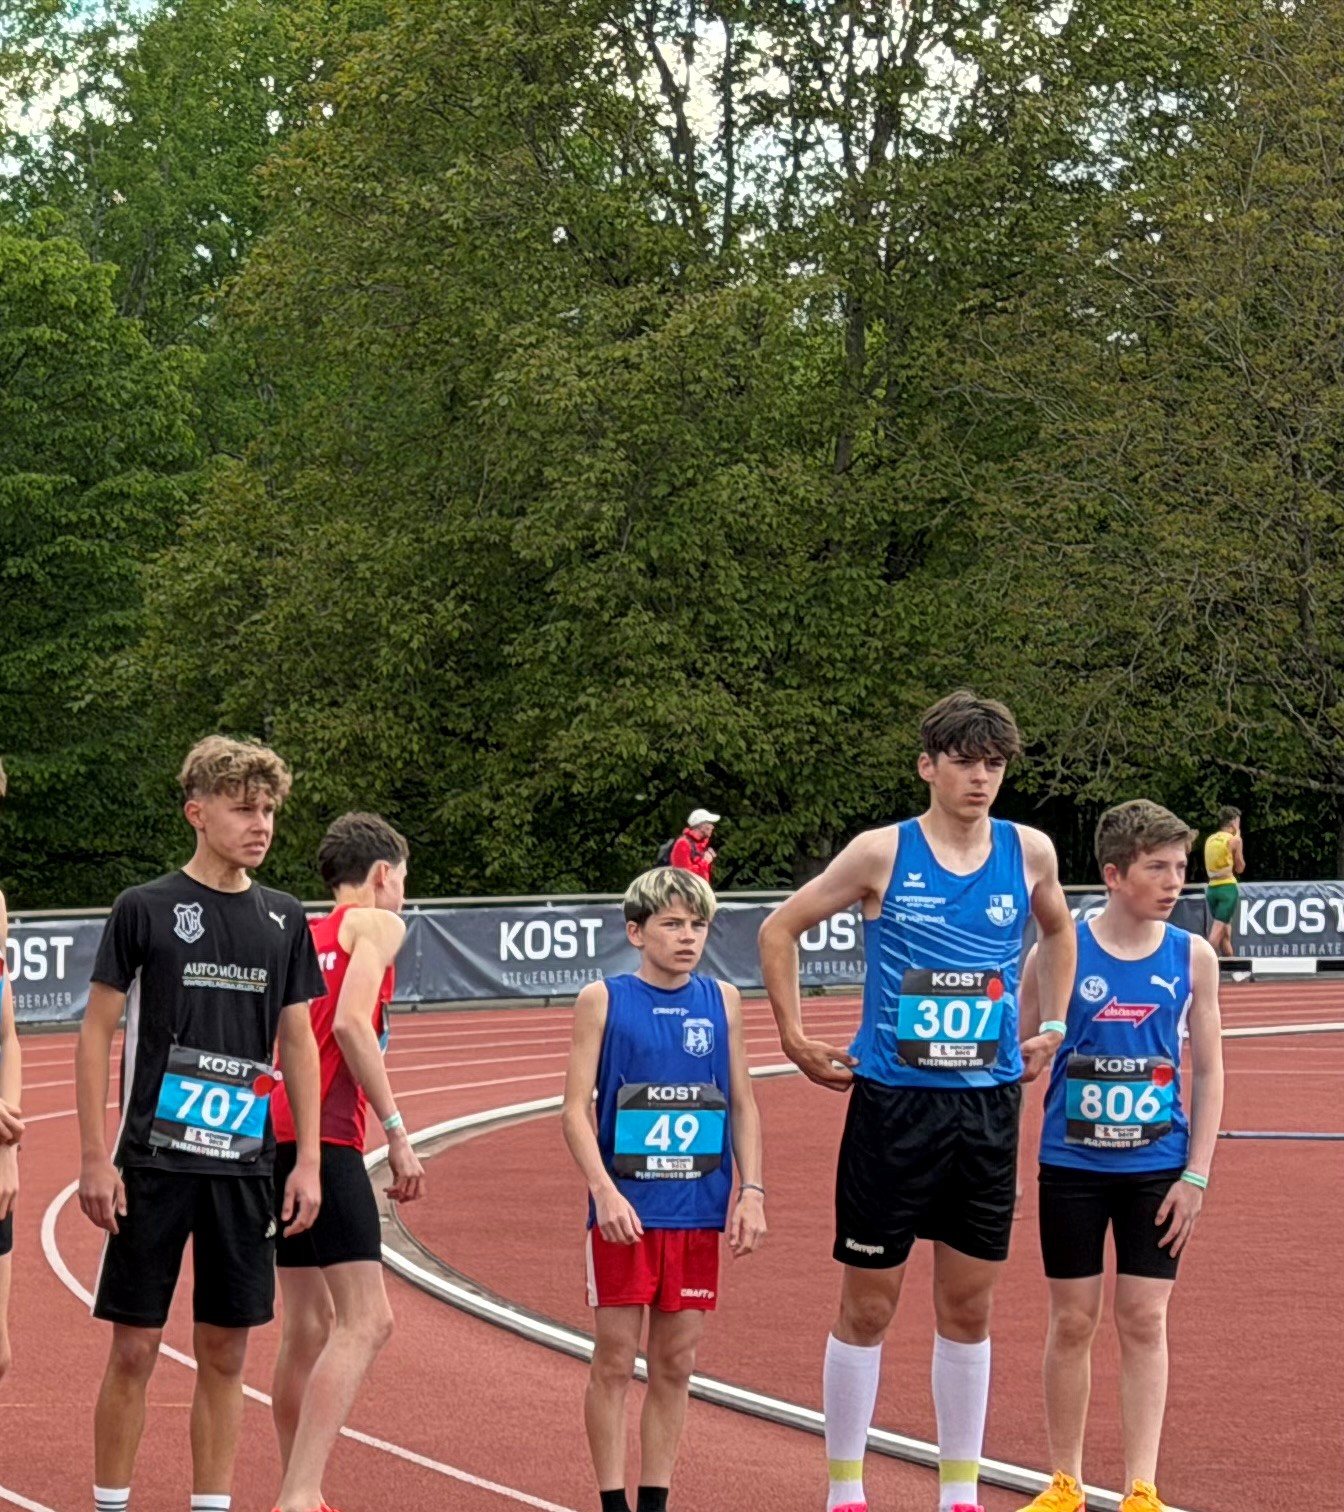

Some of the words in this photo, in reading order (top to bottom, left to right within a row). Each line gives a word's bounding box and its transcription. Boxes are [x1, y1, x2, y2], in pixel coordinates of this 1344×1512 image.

[500, 919, 603, 960] KOST
[5, 936, 73, 981] OST
[502, 968, 605, 986] STEUERBERATER
[932, 973, 983, 987] KOST
[913, 1000, 993, 1039] 307
[198, 1055, 252, 1078] KOST
[1095, 1058, 1148, 1073] KOST
[177, 1081, 255, 1131] 707
[647, 1086, 701, 1101] KOST
[1079, 1085, 1160, 1122] 806
[644, 1114, 699, 1152] 49
